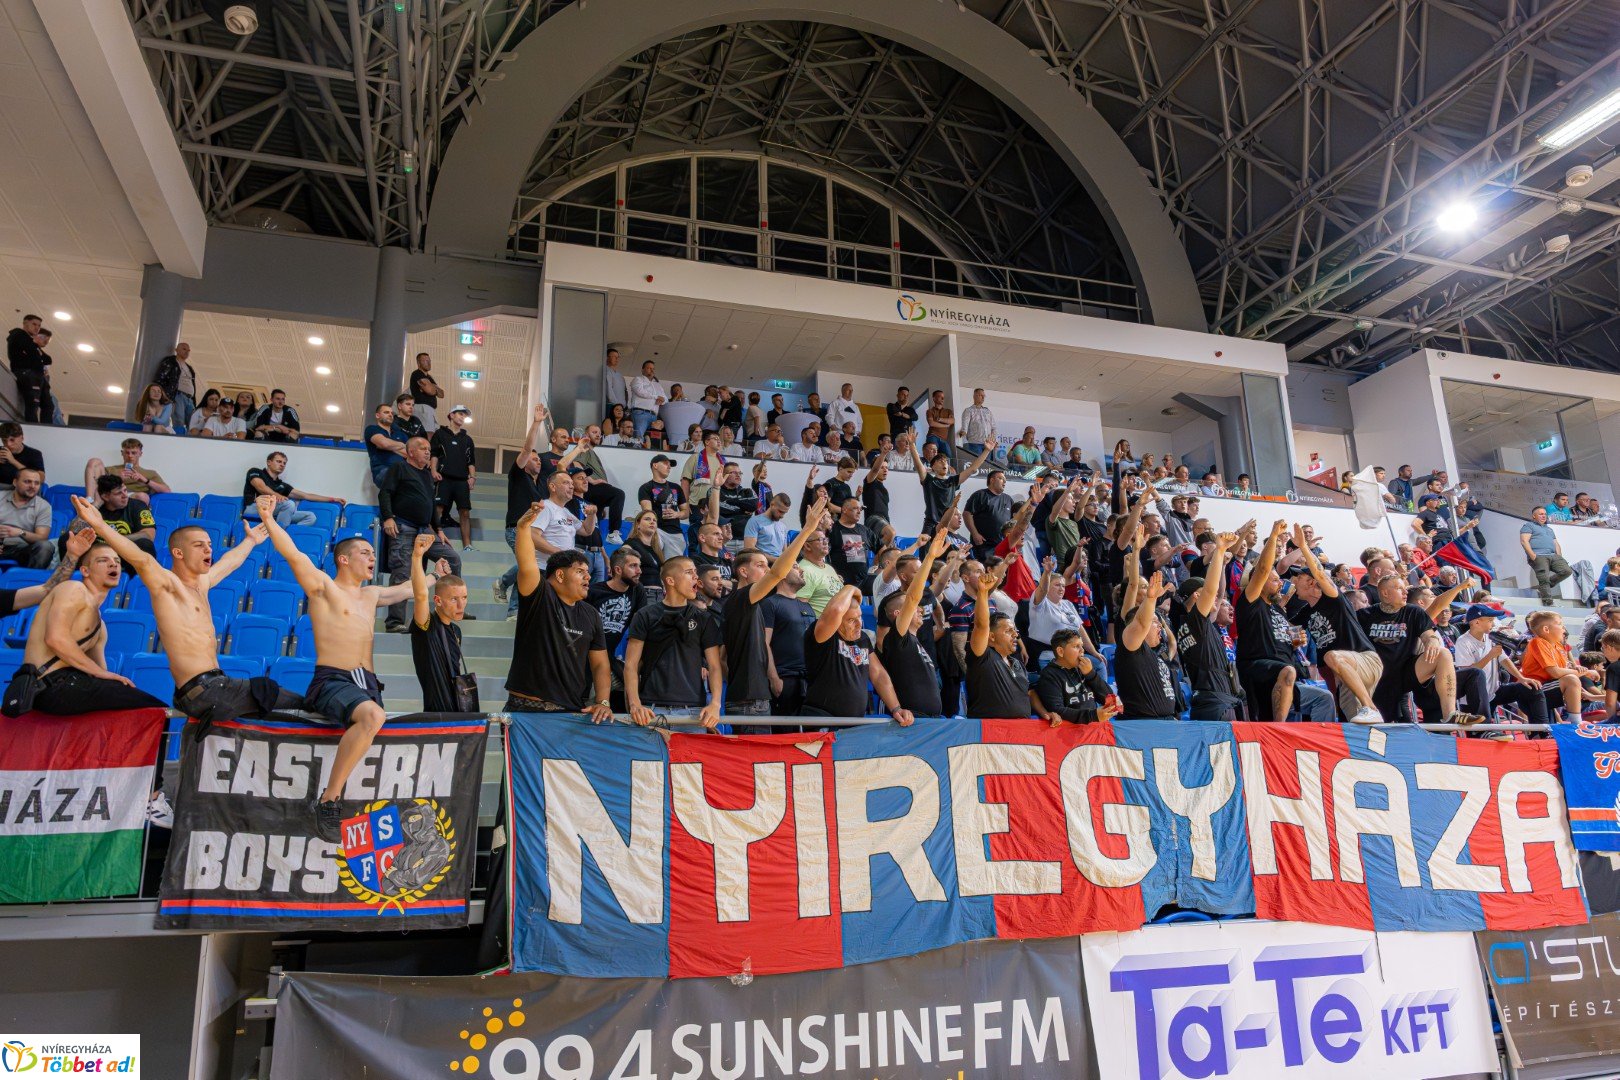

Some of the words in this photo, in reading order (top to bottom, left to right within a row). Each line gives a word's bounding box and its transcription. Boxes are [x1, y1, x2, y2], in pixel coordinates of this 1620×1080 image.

[930, 308, 1010, 327] NYÍREGYHÁZA
[1069, 691, 1095, 705] AIR
[198, 735, 458, 800] EASTERN
[346, 822, 368, 849] NY
[378, 815, 394, 840] S
[542, 728, 1582, 925] NYÍREGYHÁZA
[184, 831, 341, 894] BOYS
[361, 856, 374, 882] F
[1109, 943, 1370, 1080] Ta-Te
[1381, 996, 1453, 1056] KFT
[1503, 999, 1620, 1023] ÉPÍTÉSZ
[671, 1004, 963, 1080] SUNSHINE
[974, 996, 1070, 1066] FM
